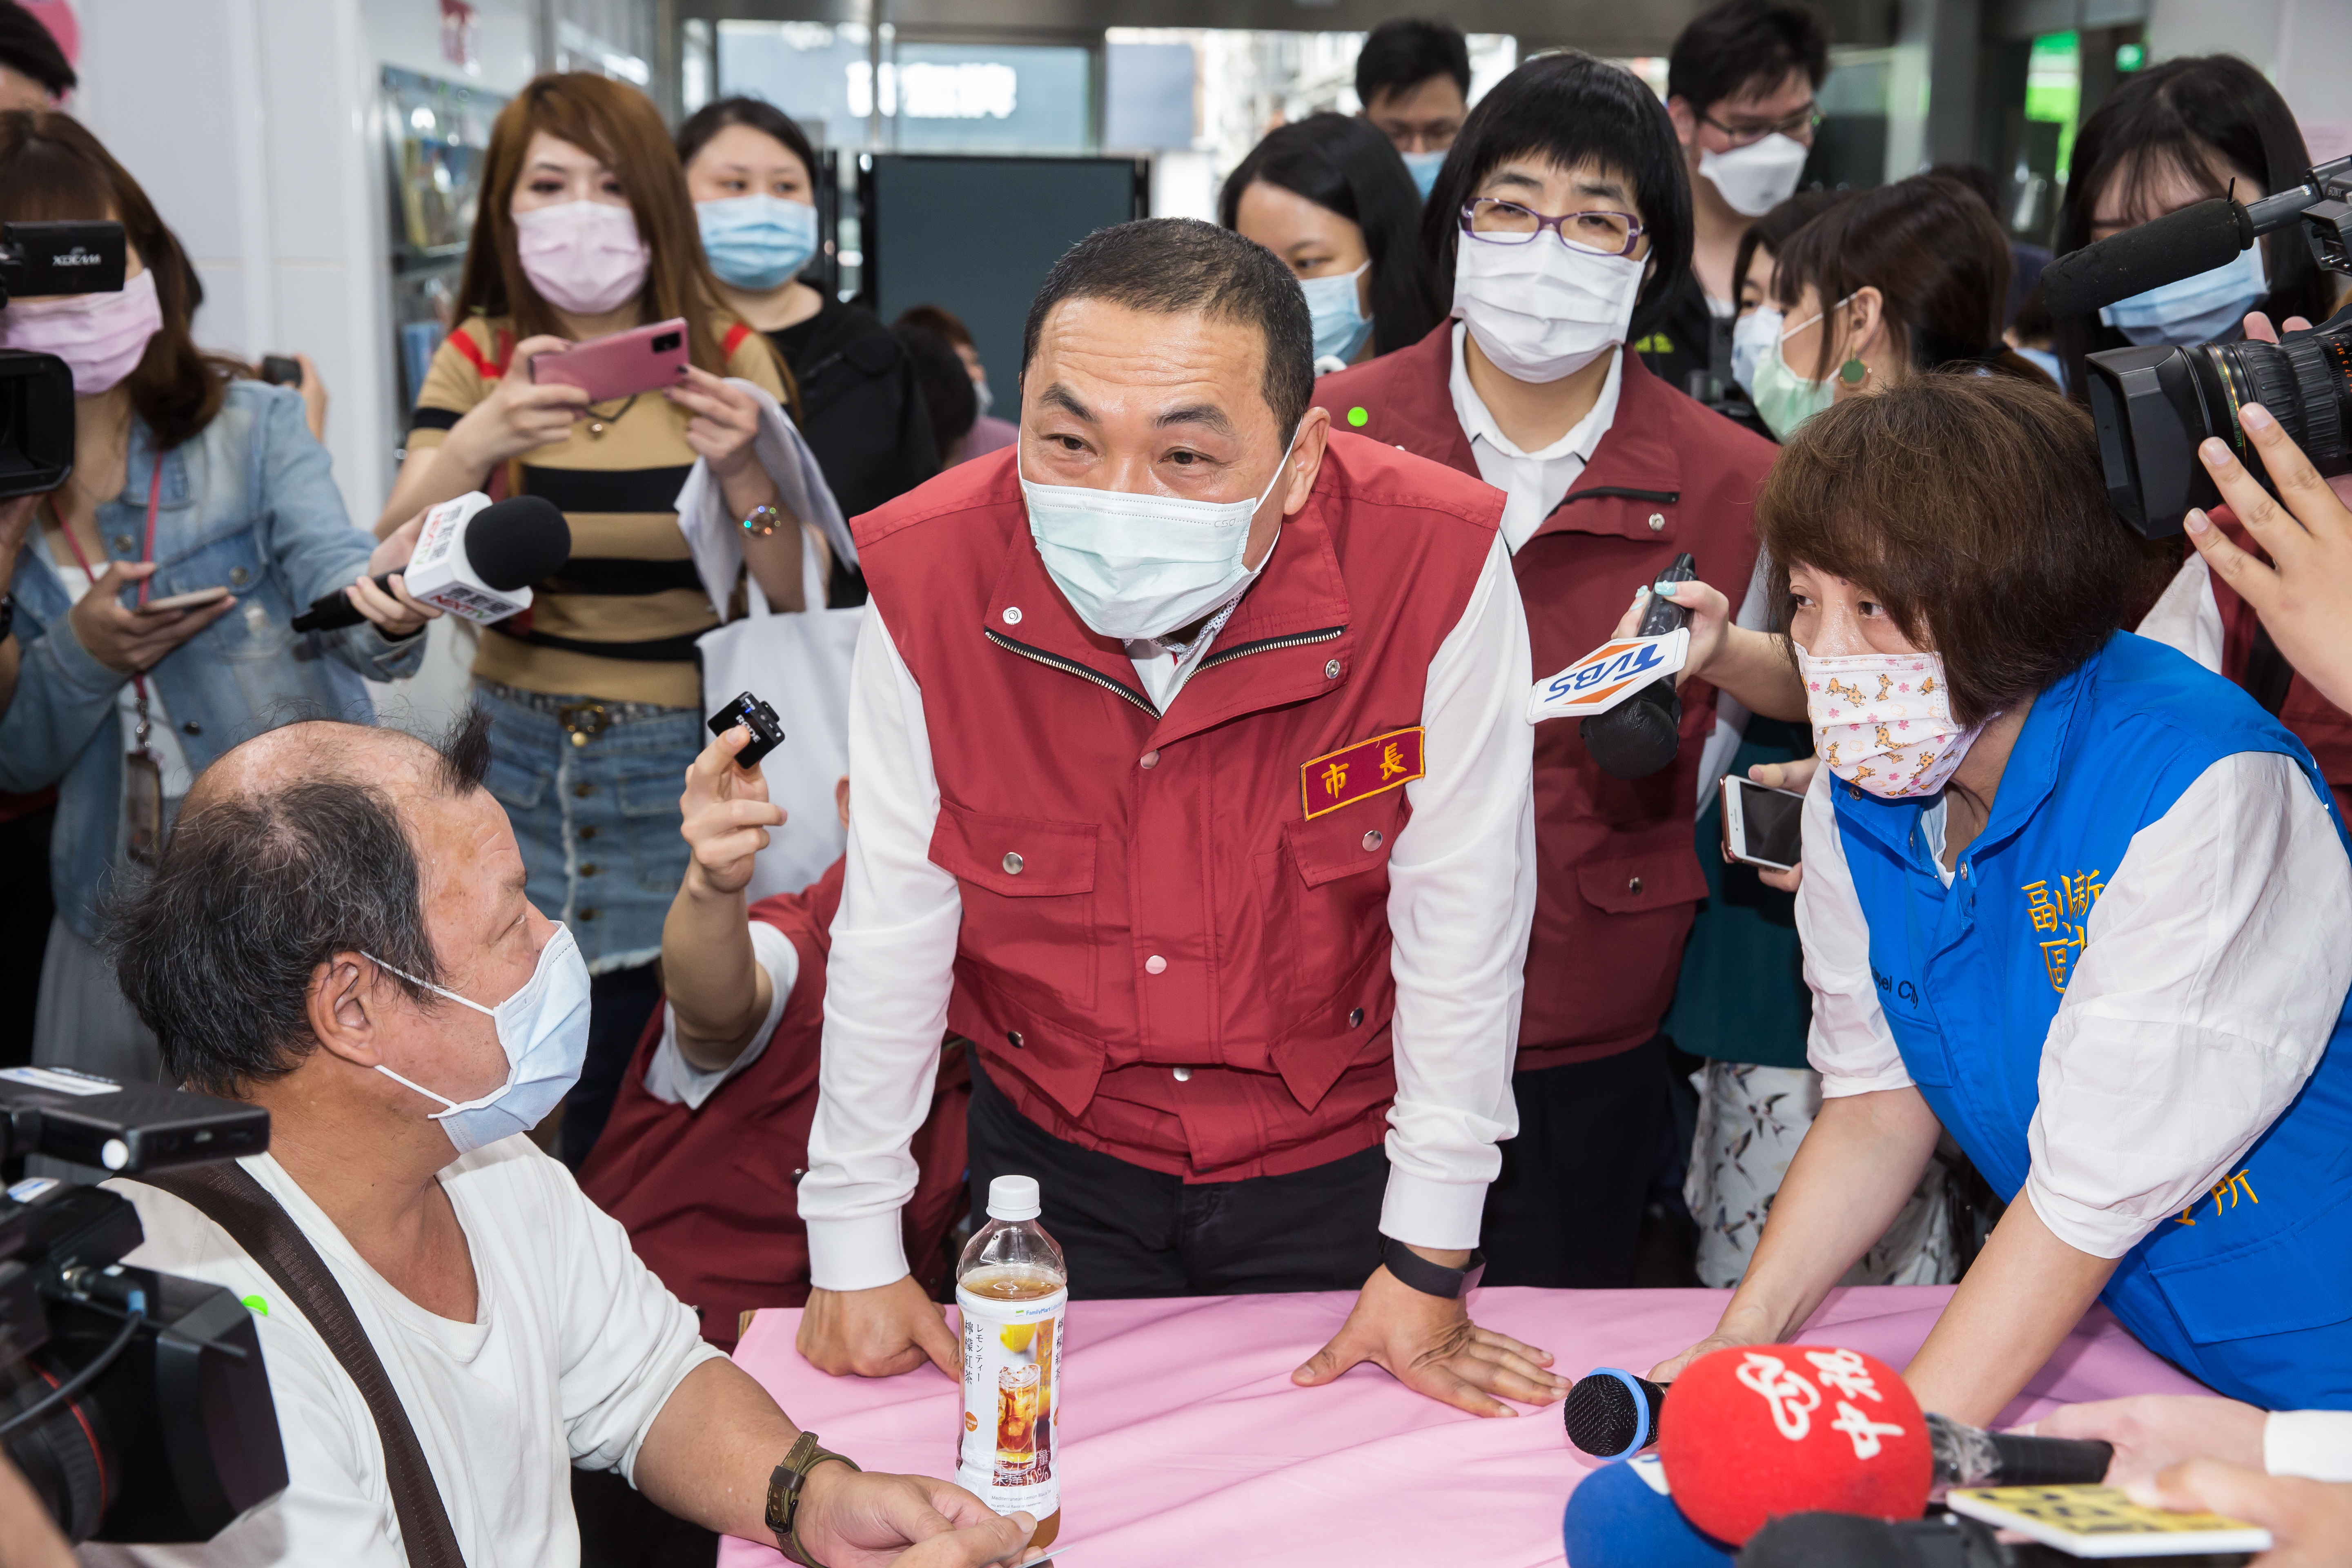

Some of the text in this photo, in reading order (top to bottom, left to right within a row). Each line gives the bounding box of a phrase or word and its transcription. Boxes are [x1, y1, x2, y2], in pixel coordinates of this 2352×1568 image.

[2230, 400, 2238, 419] JAPAN
[1544, 644, 1665, 703] TVBS
[1321, 742, 1407, 799] 市長
[1026, 1307, 1051, 1316] FamilyMart
[965, 1319, 973, 1385] 檸檬紅茶
[976, 1324, 984, 1382] レモンティー
[995, 1448, 1050, 1471] 果汁含量
